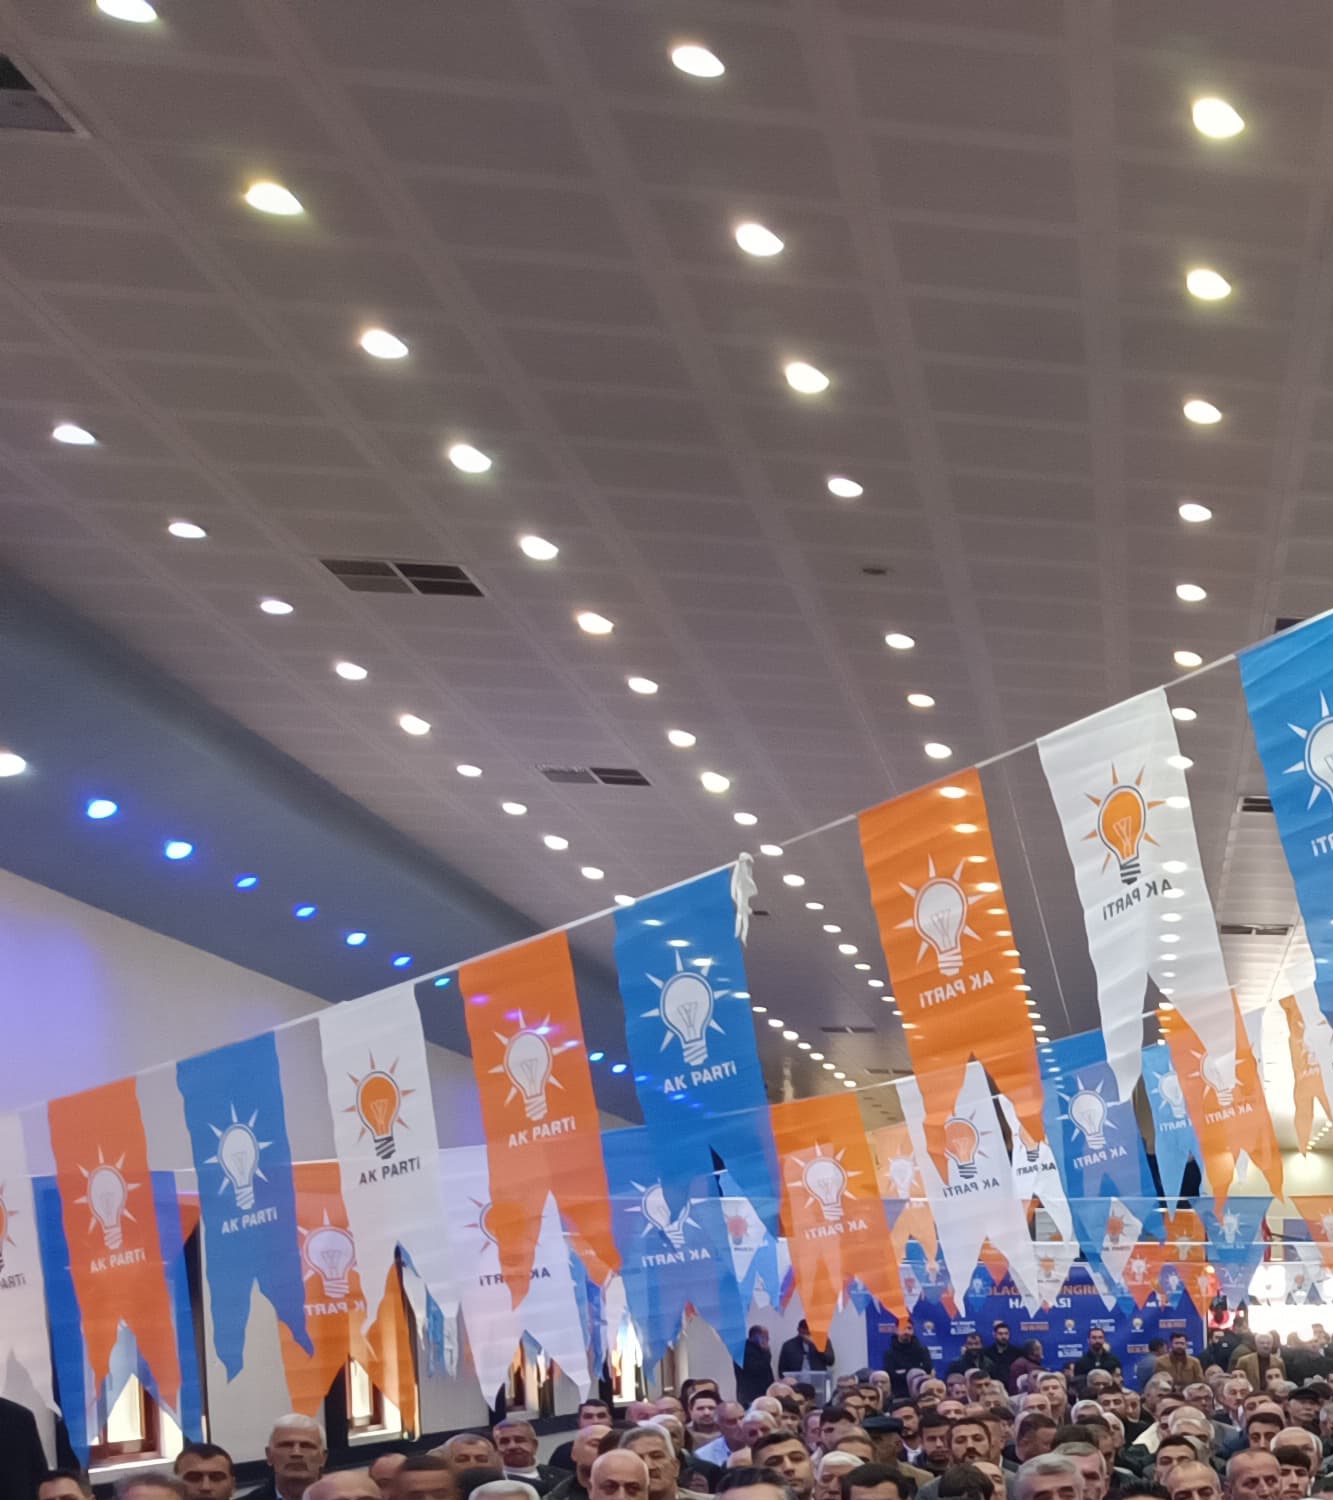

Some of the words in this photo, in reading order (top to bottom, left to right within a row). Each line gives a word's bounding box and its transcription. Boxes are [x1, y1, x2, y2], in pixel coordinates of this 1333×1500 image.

[663, 1075, 687, 1095] AK
[508, 1128, 529, 1148] AK
[359, 1169, 378, 1185] AK
[221, 1217, 239, 1235] AK
[90, 1257, 108, 1274] AK
